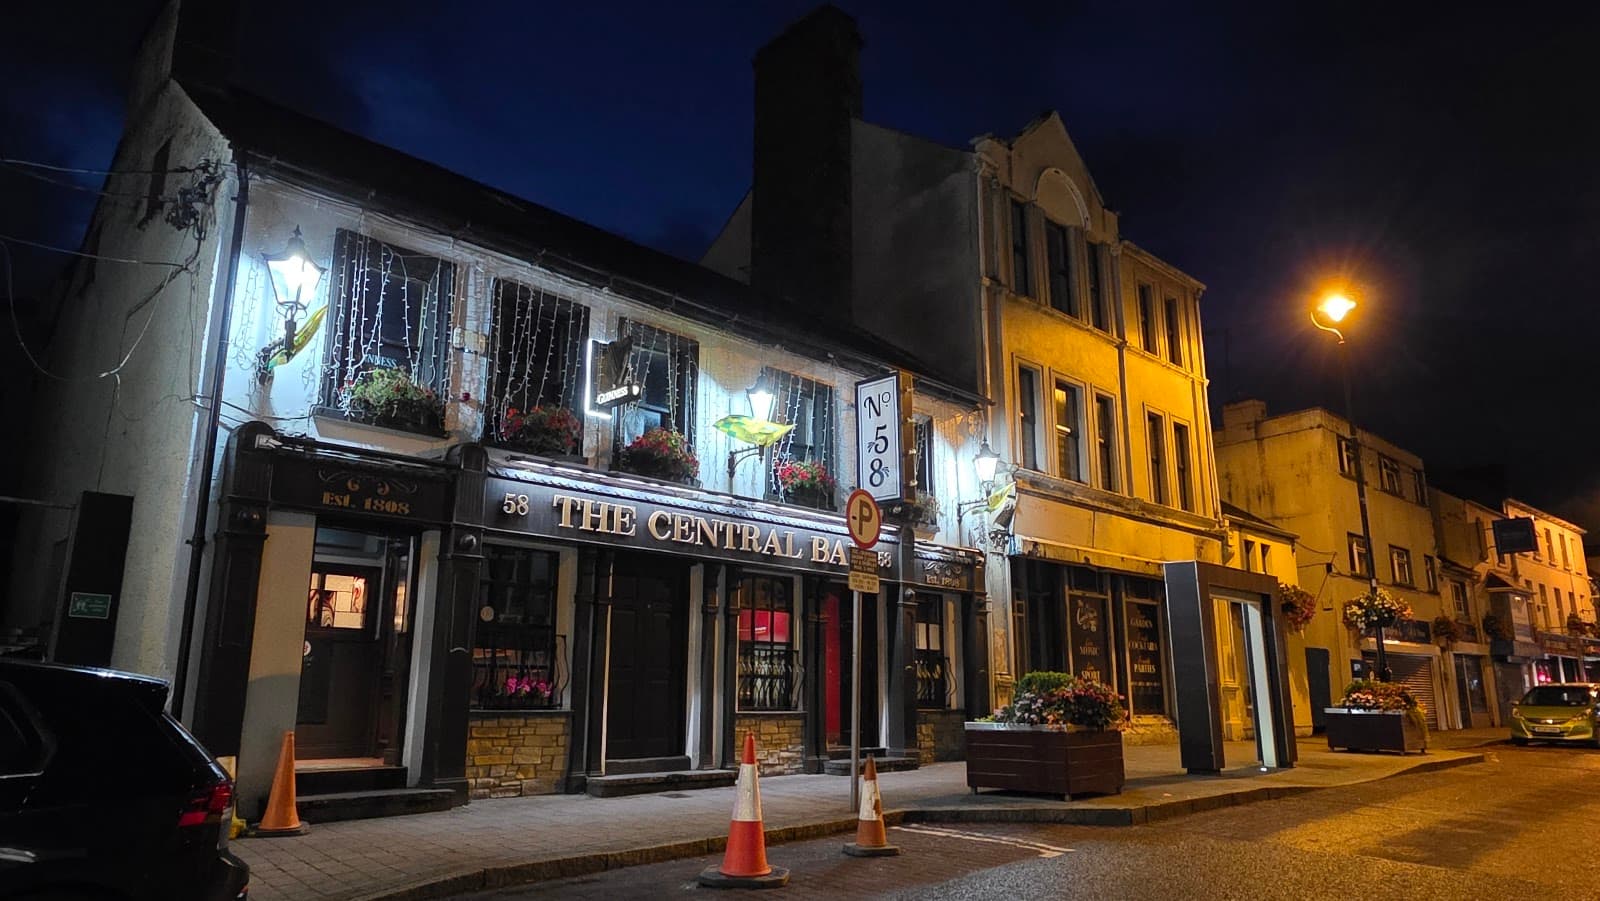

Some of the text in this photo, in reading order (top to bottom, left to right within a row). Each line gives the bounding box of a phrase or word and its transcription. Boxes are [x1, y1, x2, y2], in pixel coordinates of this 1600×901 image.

[363, 496, 410, 515] 1808
[859, 499, 873, 536] P
[502, 493, 529, 516] 58
[552, 494, 637, 537] THE
[648, 511, 804, 560] CENTRAL
[811, 535, 857, 566] BA
[878, 551, 892, 568] 58
